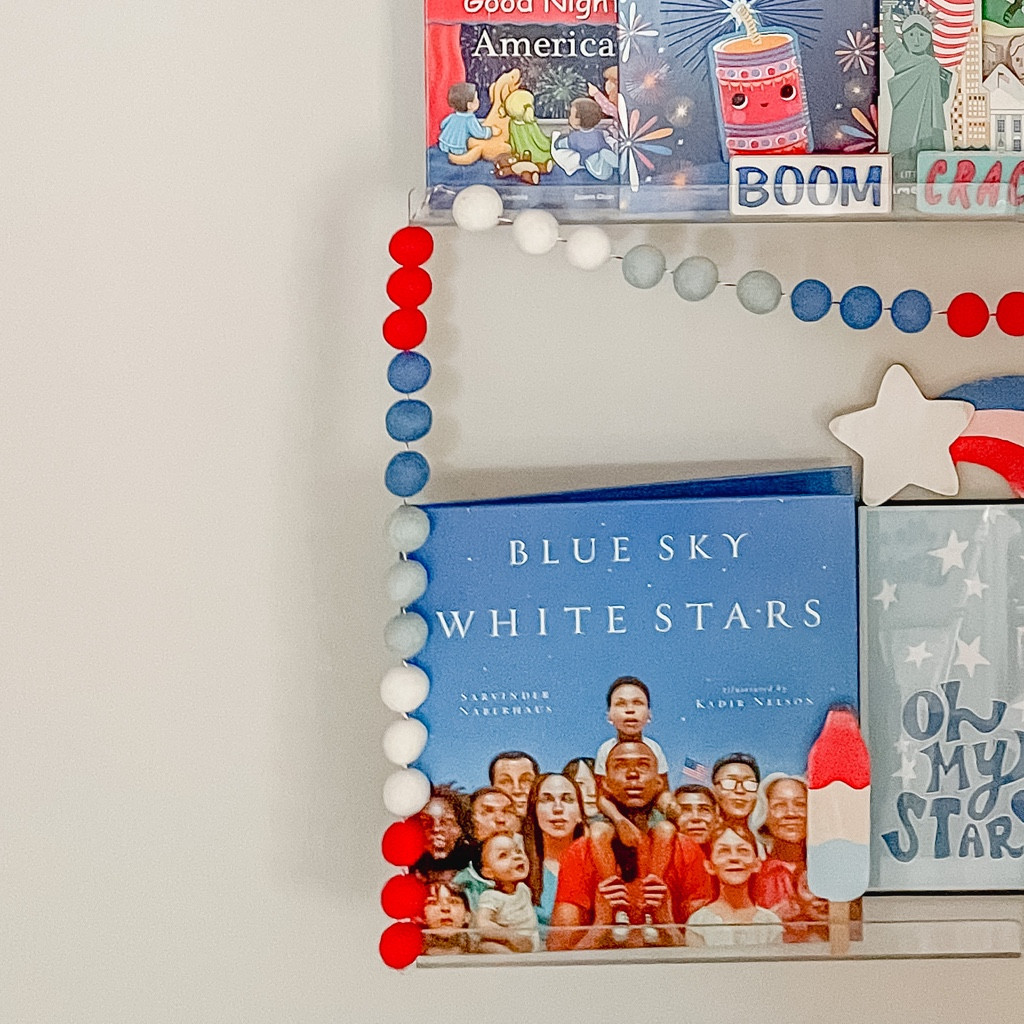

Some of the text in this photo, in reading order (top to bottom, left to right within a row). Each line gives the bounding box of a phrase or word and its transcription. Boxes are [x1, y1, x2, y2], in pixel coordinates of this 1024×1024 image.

[472, 28, 615, 57] America
[736, 165, 882, 209] BOOM
[509, 532, 749, 566] BLUE SKY
[435, 598, 822, 639] WHITE STARS
[902, 680, 1007, 742] Oh
